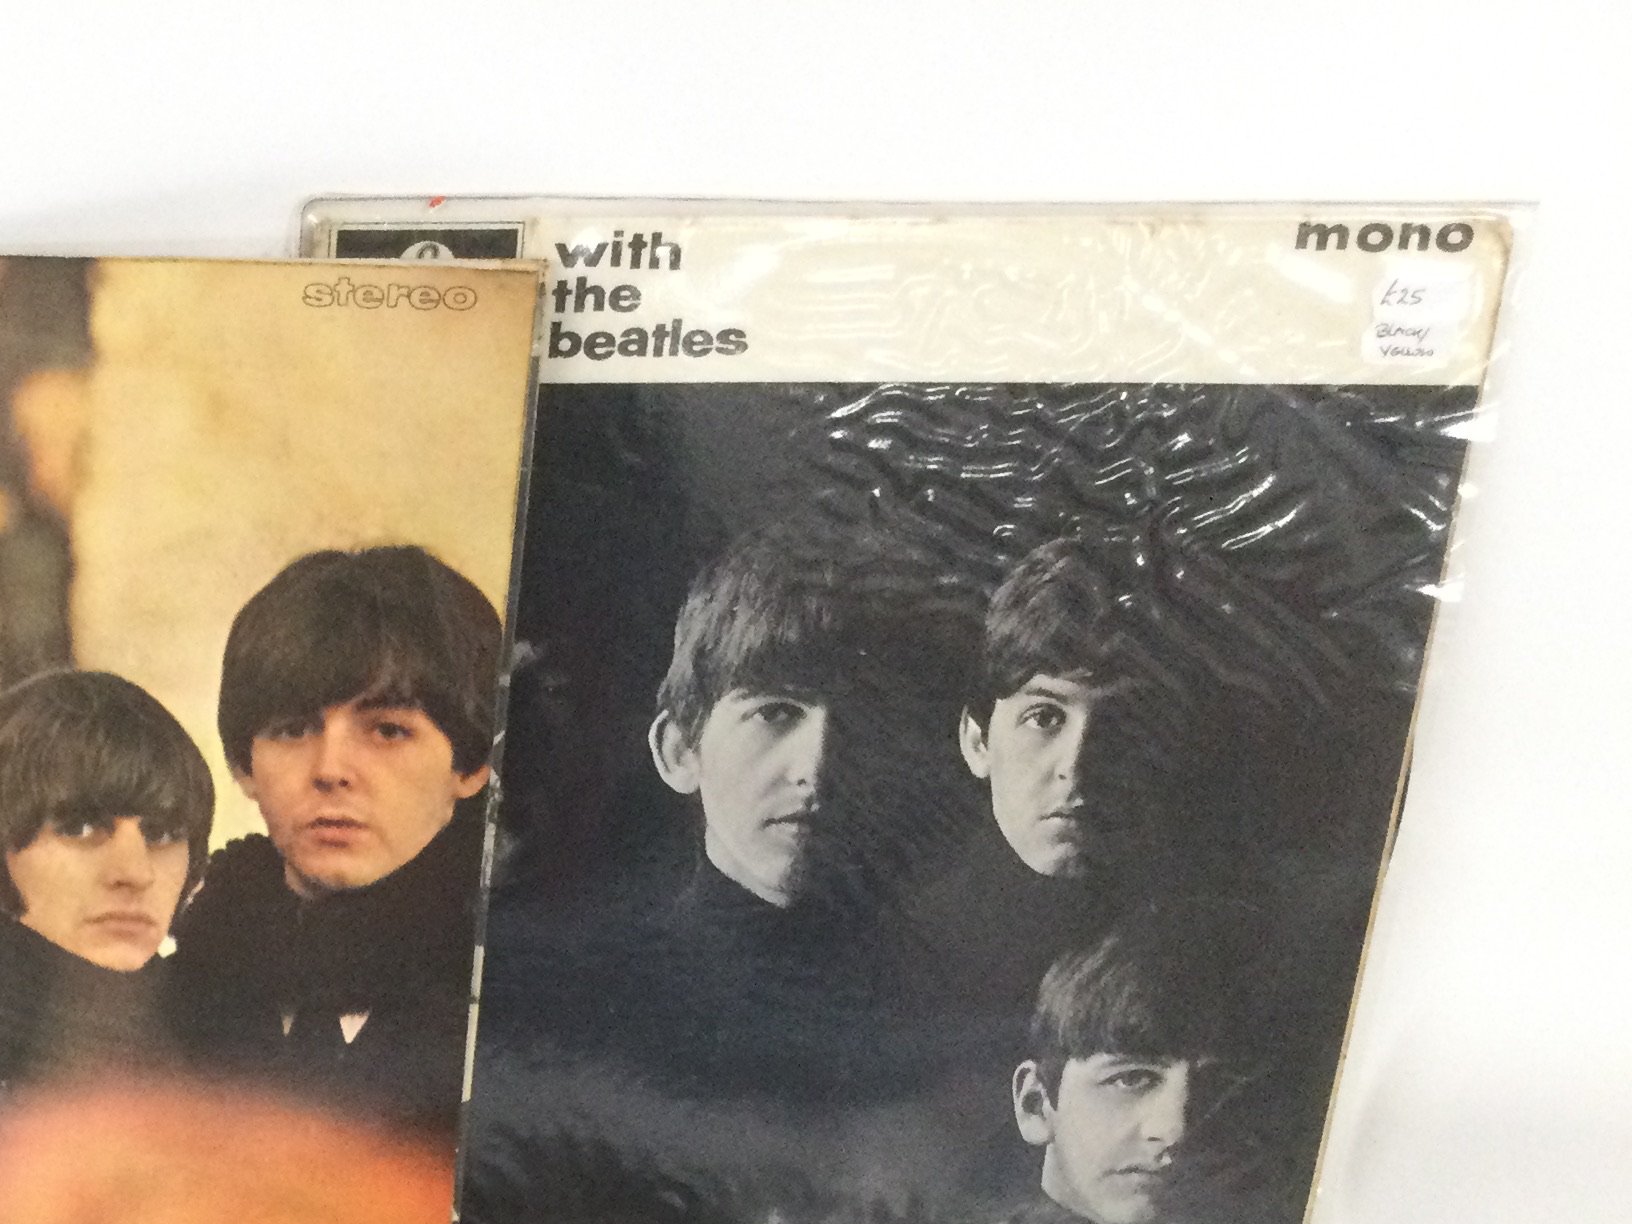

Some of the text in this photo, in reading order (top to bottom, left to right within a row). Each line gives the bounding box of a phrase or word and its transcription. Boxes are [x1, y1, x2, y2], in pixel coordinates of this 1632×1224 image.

[555, 230, 682, 271] with
[1295, 222, 1475, 253] mono
[302, 276, 478, 311] stereo
[551, 277, 642, 313] the
[548, 318, 749, 361] beatles
